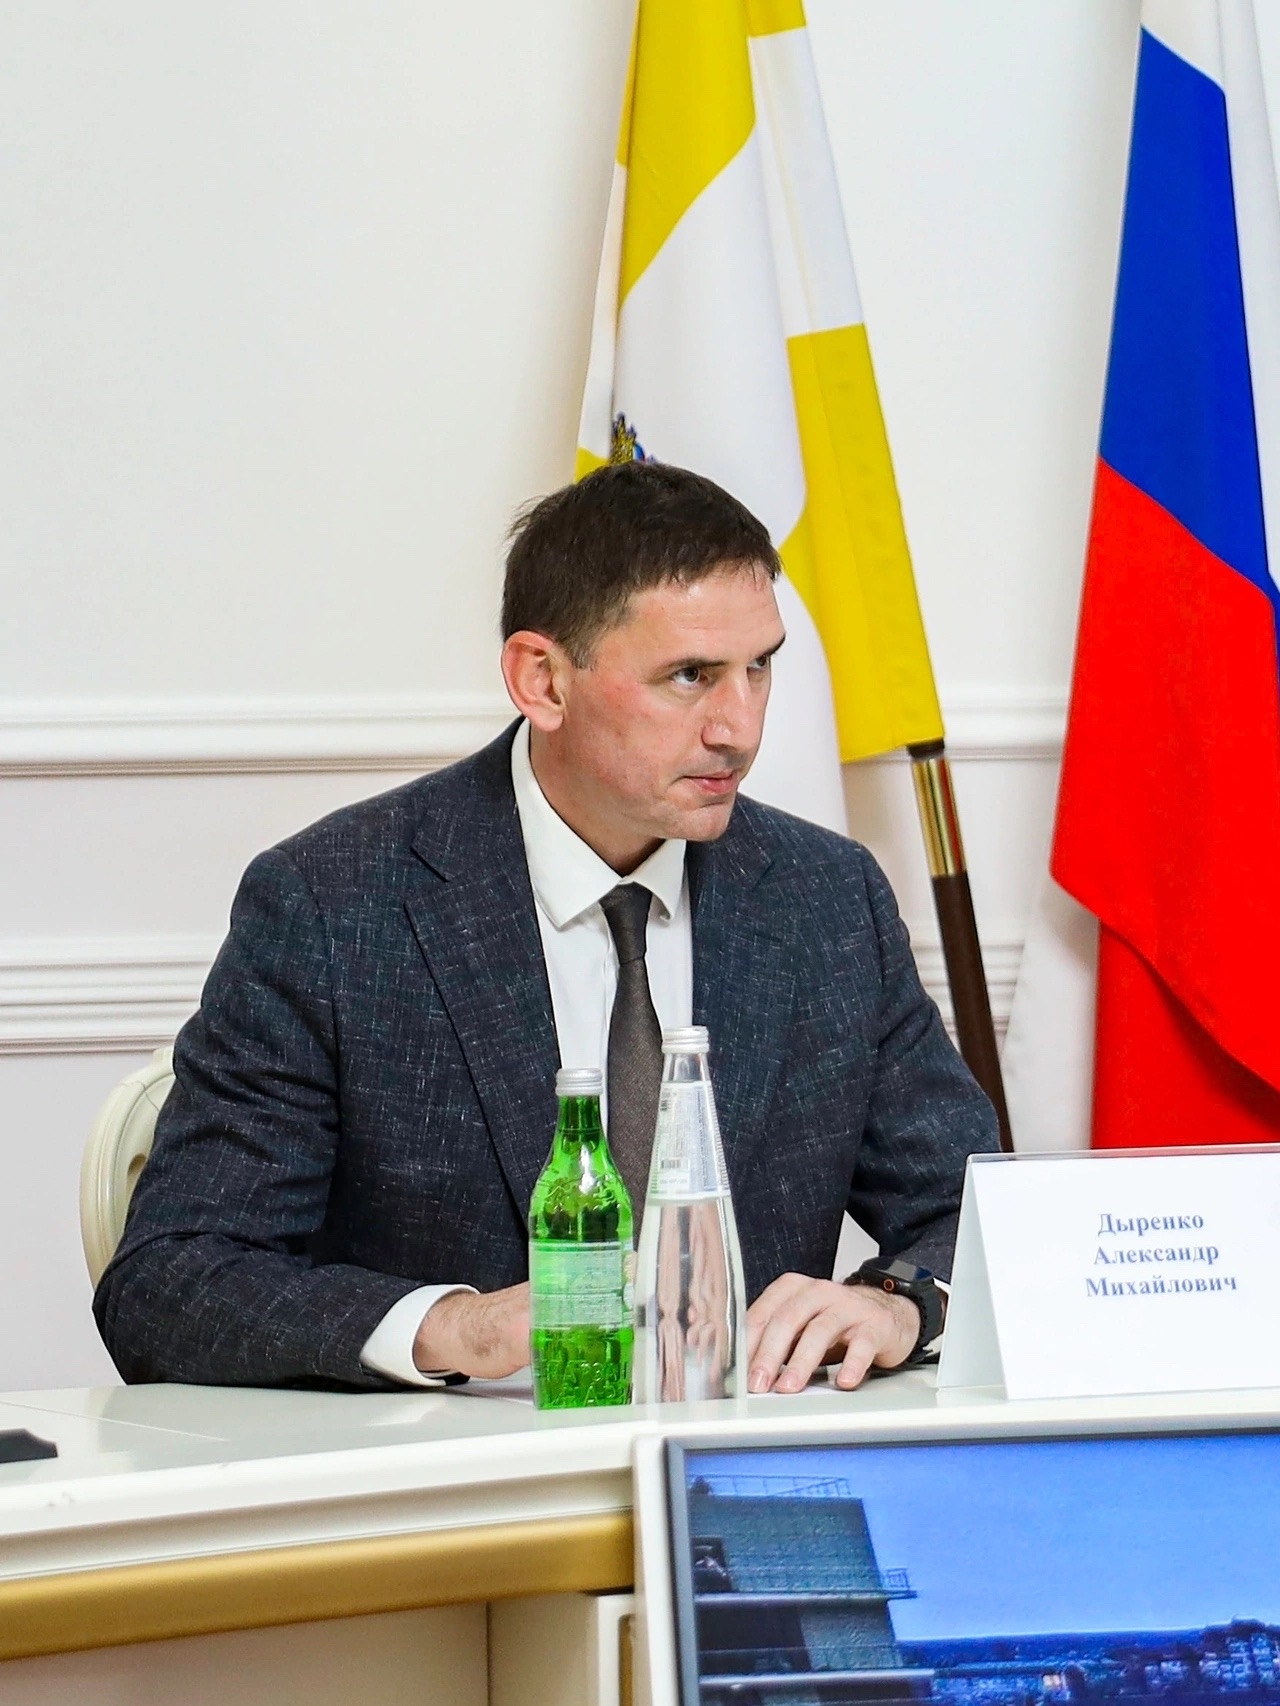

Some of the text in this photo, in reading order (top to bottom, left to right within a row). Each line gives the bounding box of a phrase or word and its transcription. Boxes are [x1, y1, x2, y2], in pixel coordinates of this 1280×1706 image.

[1097, 1213, 1204, 1237] Дыренко
[1094, 1245, 1219, 1266] Александр
[1085, 1275, 1237, 1298] Михайлович
